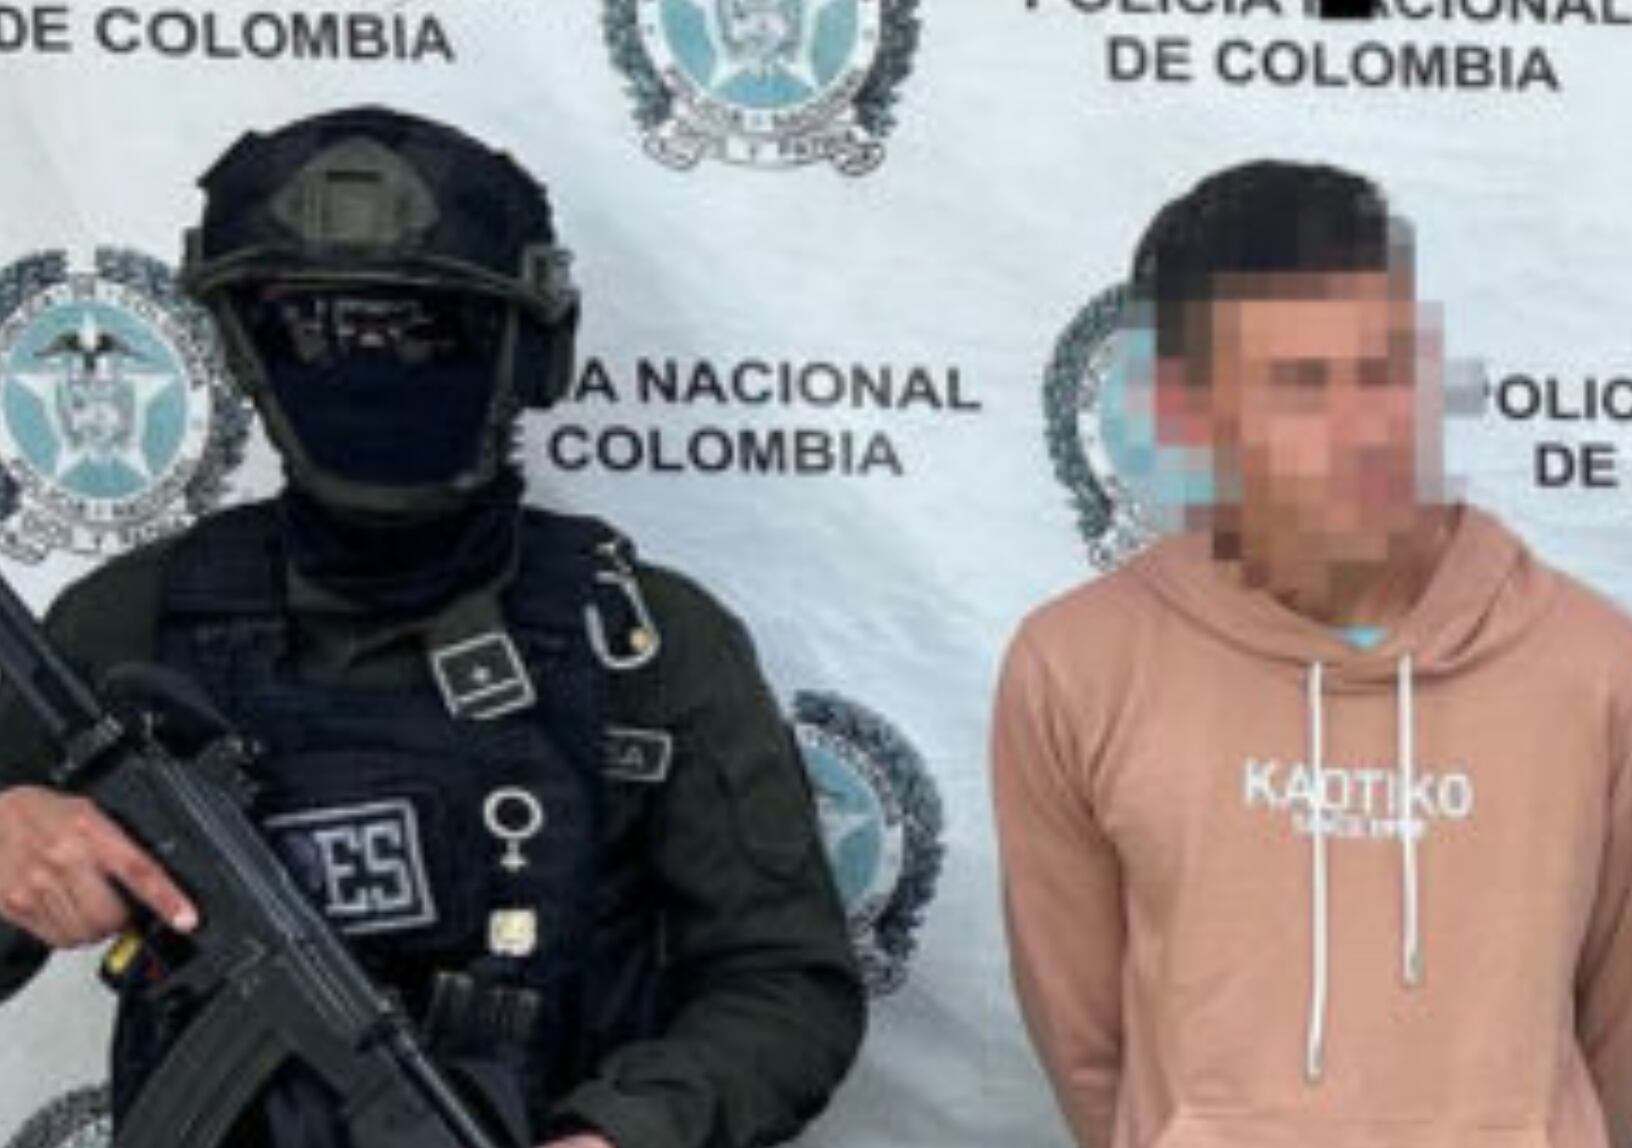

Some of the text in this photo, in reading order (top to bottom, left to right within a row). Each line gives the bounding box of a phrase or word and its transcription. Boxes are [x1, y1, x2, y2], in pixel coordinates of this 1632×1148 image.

[95, 8, 455, 62] COLOMBIA
[1106, 37, 1560, 91] DE COLOMBIA
[637, 357, 982, 411] NACIONAL
[547, 424, 904, 477] COLOMBIA
[1534, 442, 1620, 489] DE
